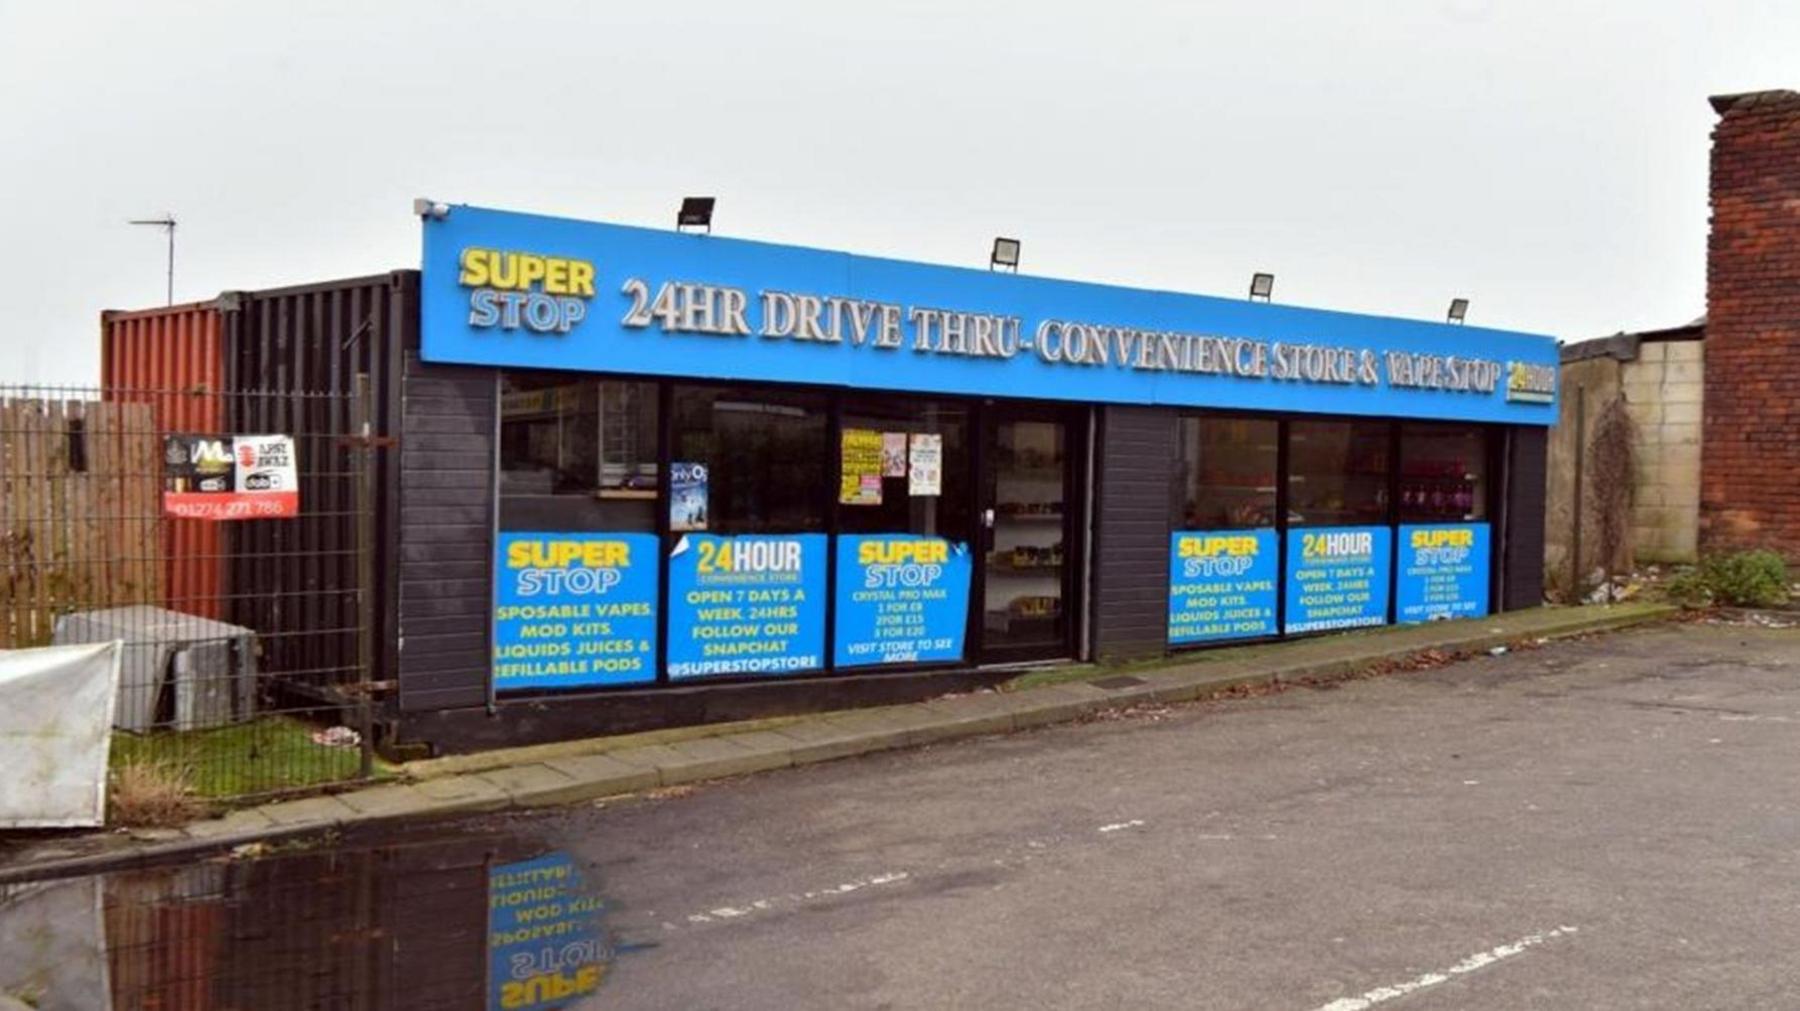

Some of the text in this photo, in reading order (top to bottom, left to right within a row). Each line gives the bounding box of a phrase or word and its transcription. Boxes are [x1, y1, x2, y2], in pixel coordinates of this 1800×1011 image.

[459, 247, 596, 296] SUPER
[469, 288, 585, 332] STOP
[622, 277, 750, 335] 24HR
[758, 289, 900, 348] DRIVE
[1271, 342, 1356, 382] STORE
[1358, 348, 1378, 384] &
[1382, 349, 1443, 388] VAPE
[1443, 354, 1500, 392] STOP
[1178, 537, 1258, 557] SUPER
[1302, 532, 1372, 557] 24HOUR
[1411, 529, 1473, 548] SUPER
[507, 540, 630, 568] SUPER
[697, 540, 801, 572] 24HOUR
[858, 540, 948, 564] SUPER
[1415, 547, 1470, 565] STOP
[1184, 556, 1253, 577] STOP
[516, 568, 620, 596] STOP
[865, 564, 941, 588] STOP
[687, 588, 805, 604] OPEN 7 DAYS A
[923, 588, 947, 599] MAX
[887, 602, 907, 612] FOR
[1186, 597, 1217, 608] MOD
[750, 605, 797, 619] 24HRS
[520, 624, 567, 638] MOD
[692, 623, 798, 639] FOLLOW OUR
[883, 626, 903, 637] FOR
[1234, 620, 1265, 632] PODS
[576, 640, 633, 655] JUICES
[639, 640, 650, 652] &
[703, 640, 788, 656] SNAPCHAT
[848, 638, 953, 654] VISIT STORE TO SEE
[593, 657, 641, 672] PODS
